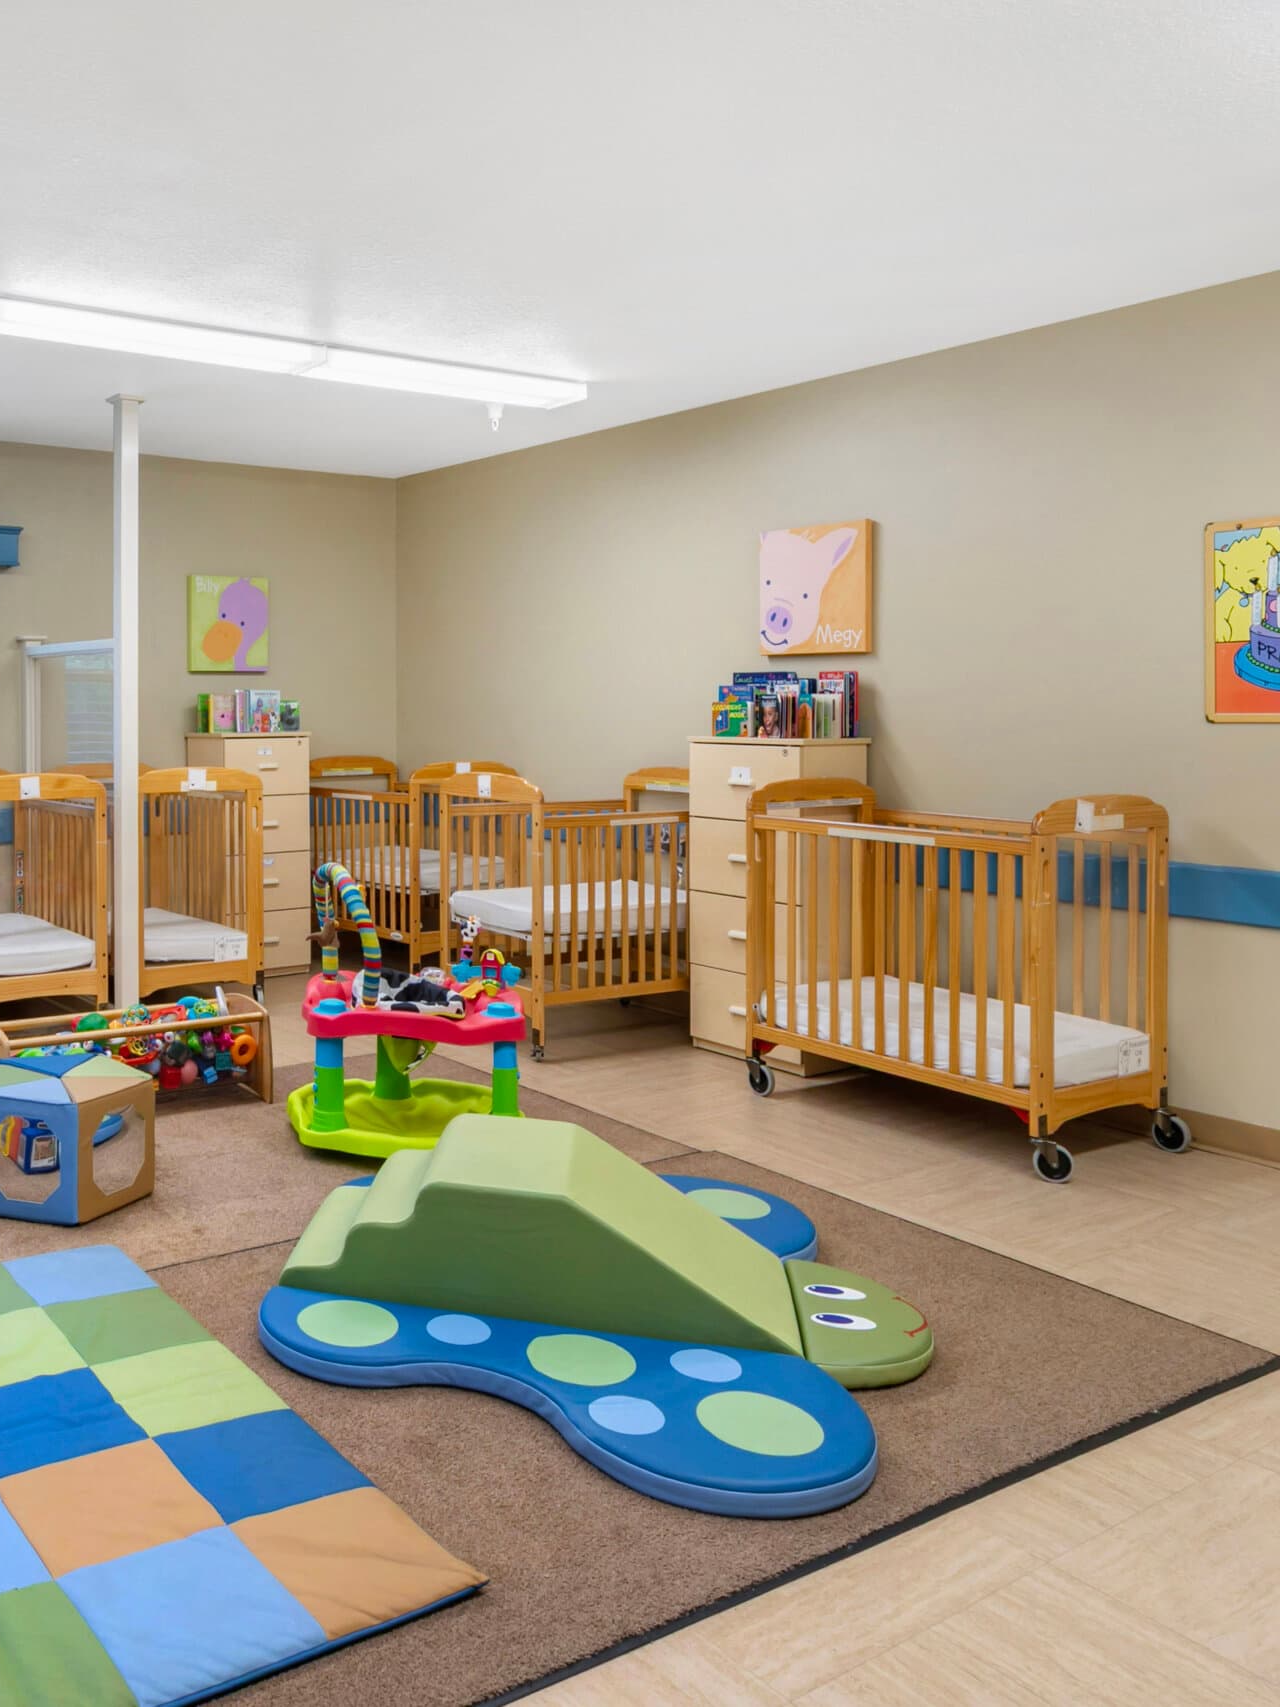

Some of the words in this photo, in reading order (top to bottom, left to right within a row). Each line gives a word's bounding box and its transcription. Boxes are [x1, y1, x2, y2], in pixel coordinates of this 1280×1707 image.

[195, 576, 220, 599] Billy
[816, 623, 863, 649] Megy
[1258, 640, 1280, 662] PR
